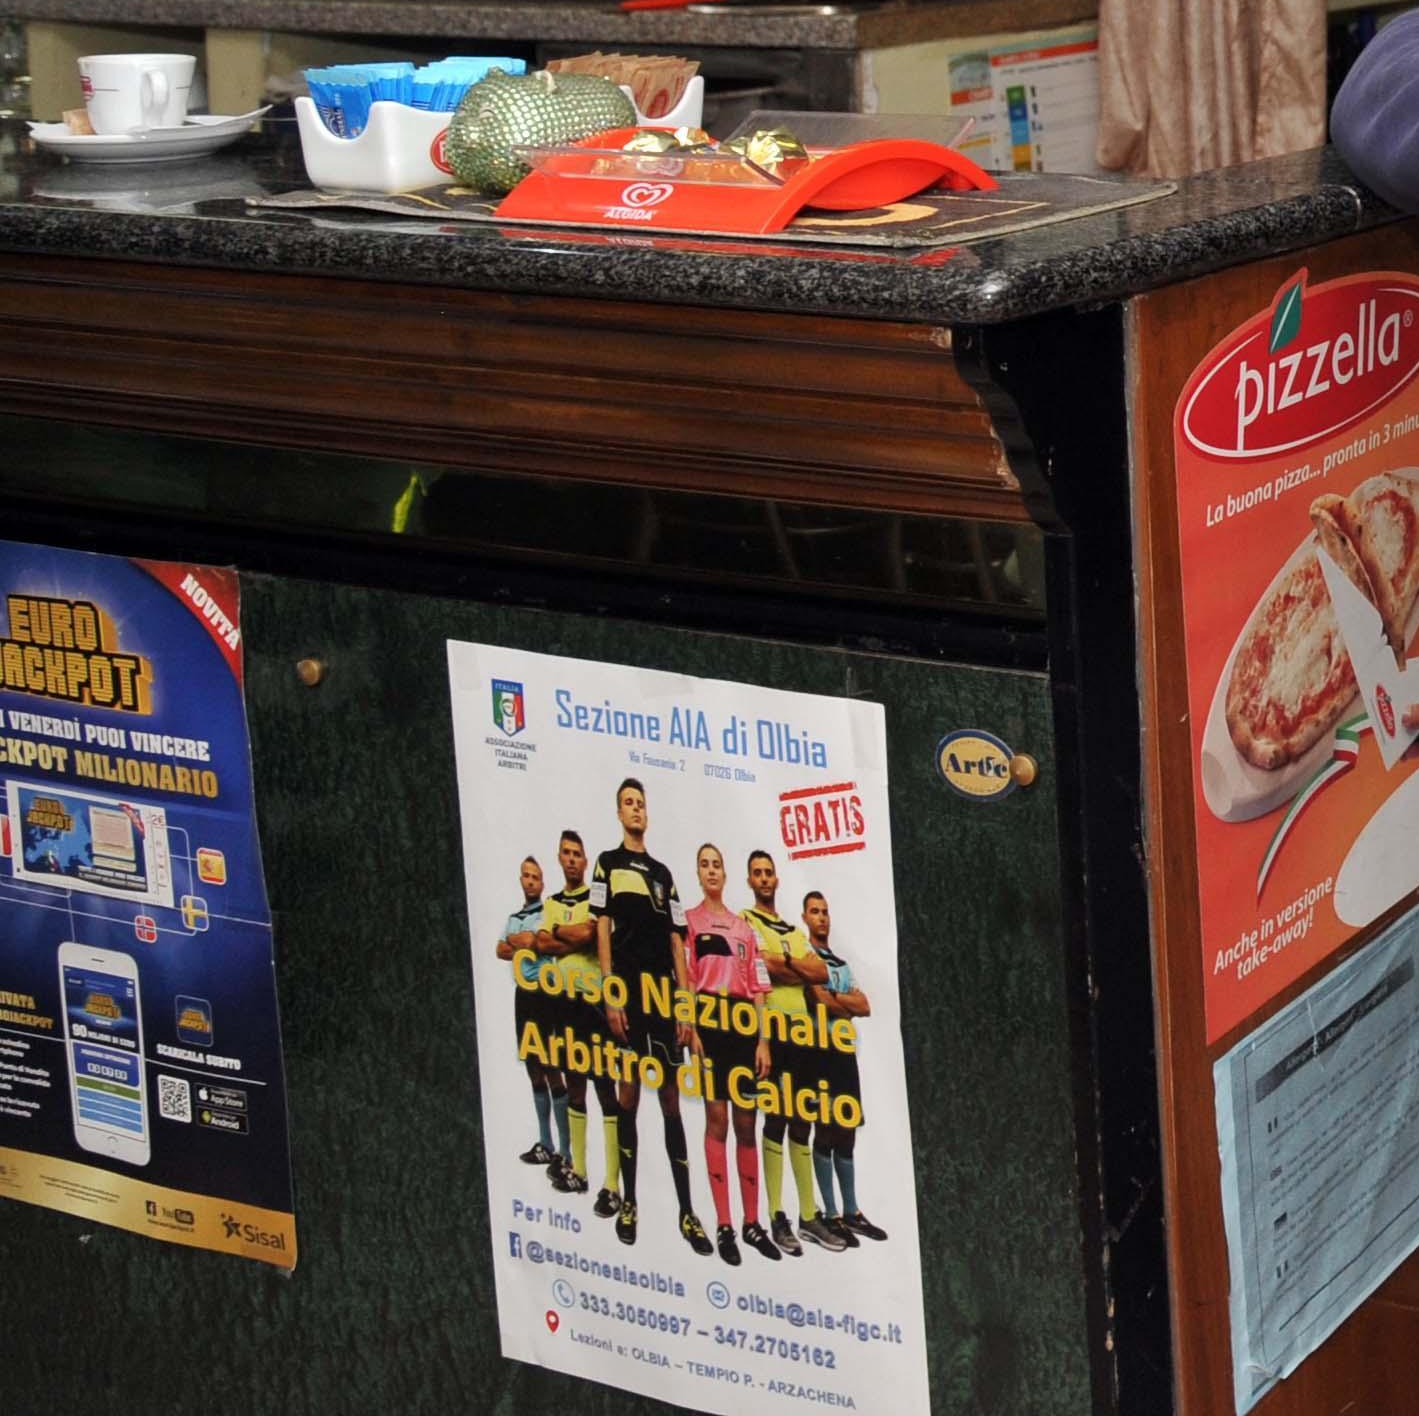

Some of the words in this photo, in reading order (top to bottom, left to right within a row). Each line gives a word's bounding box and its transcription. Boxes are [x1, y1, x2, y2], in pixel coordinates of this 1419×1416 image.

[602, 206, 654, 221] ALGIDA
[1235, 298, 1402, 451] pizzella
[1206, 502, 1225, 528] La
[1226, 482, 1273, 517] buona
[1323, 440, 1367, 478] pronta
[1368, 432, 1381, 453] in
[1383, 425, 1393, 445] 3
[7, 596, 99, 653] EURO
[0, 640, 138, 708] ACKPOT
[84, 723, 127, 750] PUOI
[130, 730, 211, 763] VINCERE
[485, 736, 538, 753] ASSOCIAZIONE
[494, 749, 529, 762] ITALIANA
[555, 688, 661, 743] Sezione
[669, 706, 712, 752] AIA
[722, 714, 748, 757] di
[756, 718, 828, 770] Olbia
[74, 749, 219, 799] MILIONARIO
[628, 750, 642, 764] Via
[703, 762, 732, 778] 07026
[734, 766, 757, 784] Olbia
[778, 793, 867, 849] GRATIS
[1213, 927, 1259, 975] Anche
[1260, 915, 1276, 943] in
[1275, 875, 1335, 936] versione
[1236, 908, 1315, 980] take-away!
[512, 948, 629, 1009] Corso
[640, 971, 859, 1054] Nazionale
[518, 1020, 665, 1090] Arbitro
[675, 1056, 715, 1101] di
[727, 1065, 864, 1129] Calcio
[243, 1222, 287, 1252] Sisal
[511, 1198, 544, 1224] Per
[578, 1290, 692, 1337] 333.3050997
[713, 1325, 838, 1371] 347.2705162
[569, 1327, 614, 1353] Lezioni
[631, 1343, 671, 1370] OLBIA
[686, 1359, 742, 1387] TEMPIO
[767, 1377, 858, 1411] ARZACHENA
